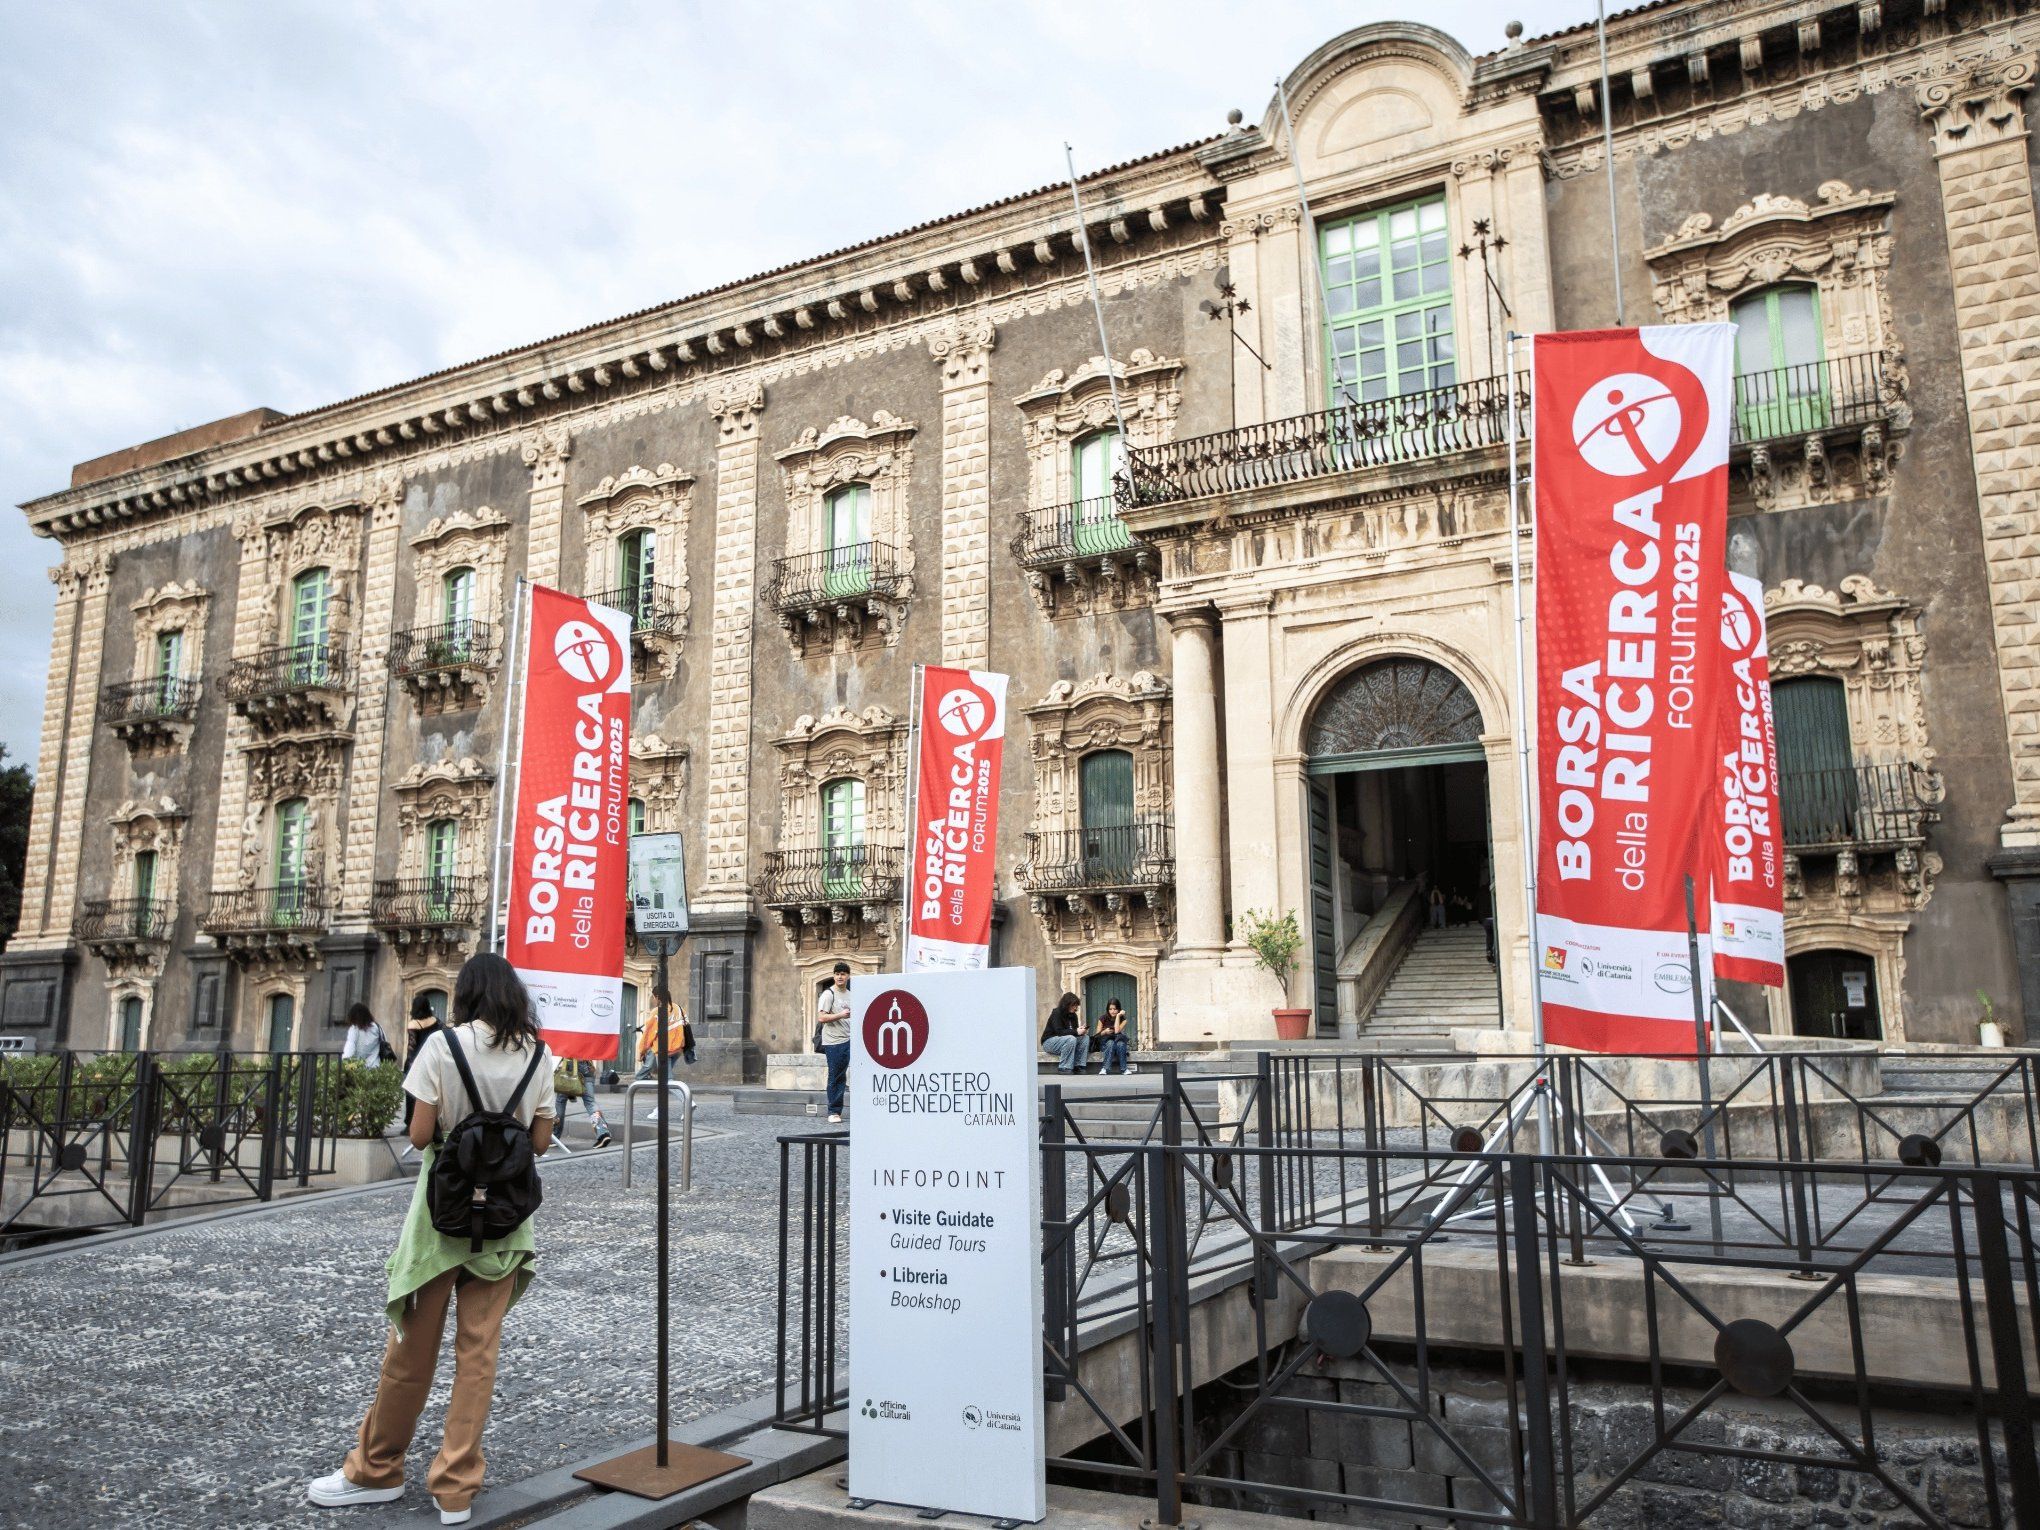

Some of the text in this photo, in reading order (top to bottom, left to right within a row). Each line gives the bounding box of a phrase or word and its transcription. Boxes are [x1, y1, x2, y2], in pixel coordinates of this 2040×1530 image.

[1601, 485, 1663, 891] della RICERCA
[1556, 660, 1601, 881] BORSA
[1732, 658, 1775, 889] della RICERCA
[563, 692, 604, 949] della RICERCA
[1724, 751, 1753, 883] BORSA
[944, 741, 976, 926] della RICERCA
[525, 795, 568, 945] BORSA
[921, 817, 947, 920] BORSA
[643, 921, 680, 929] EMERGENZA
[646, 911, 675, 920] USCITA DI
[1597, 961, 1633, 973] Università
[1603, 971, 1633, 981] Catania
[872, 1072, 991, 1093] MONASTERO
[872, 1093, 1013, 1113] dei BENEDETTINI
[964, 1113, 1016, 1126] CATANIA
[873, 1169, 1005, 1189] INFOPOINT
[892, 1209, 994, 1228] Visite Guidate
[890, 1232, 987, 1253] Guided Tours
[893, 1266, 948, 1285] Libreria
[890, 1290, 961, 1314] Bookshop
[879, 1400, 907, 1411] officine
[879, 1409, 911, 1421] culturali
[986, 1410, 1021, 1422] Università
[994, 1421, 1022, 1432] Catania
